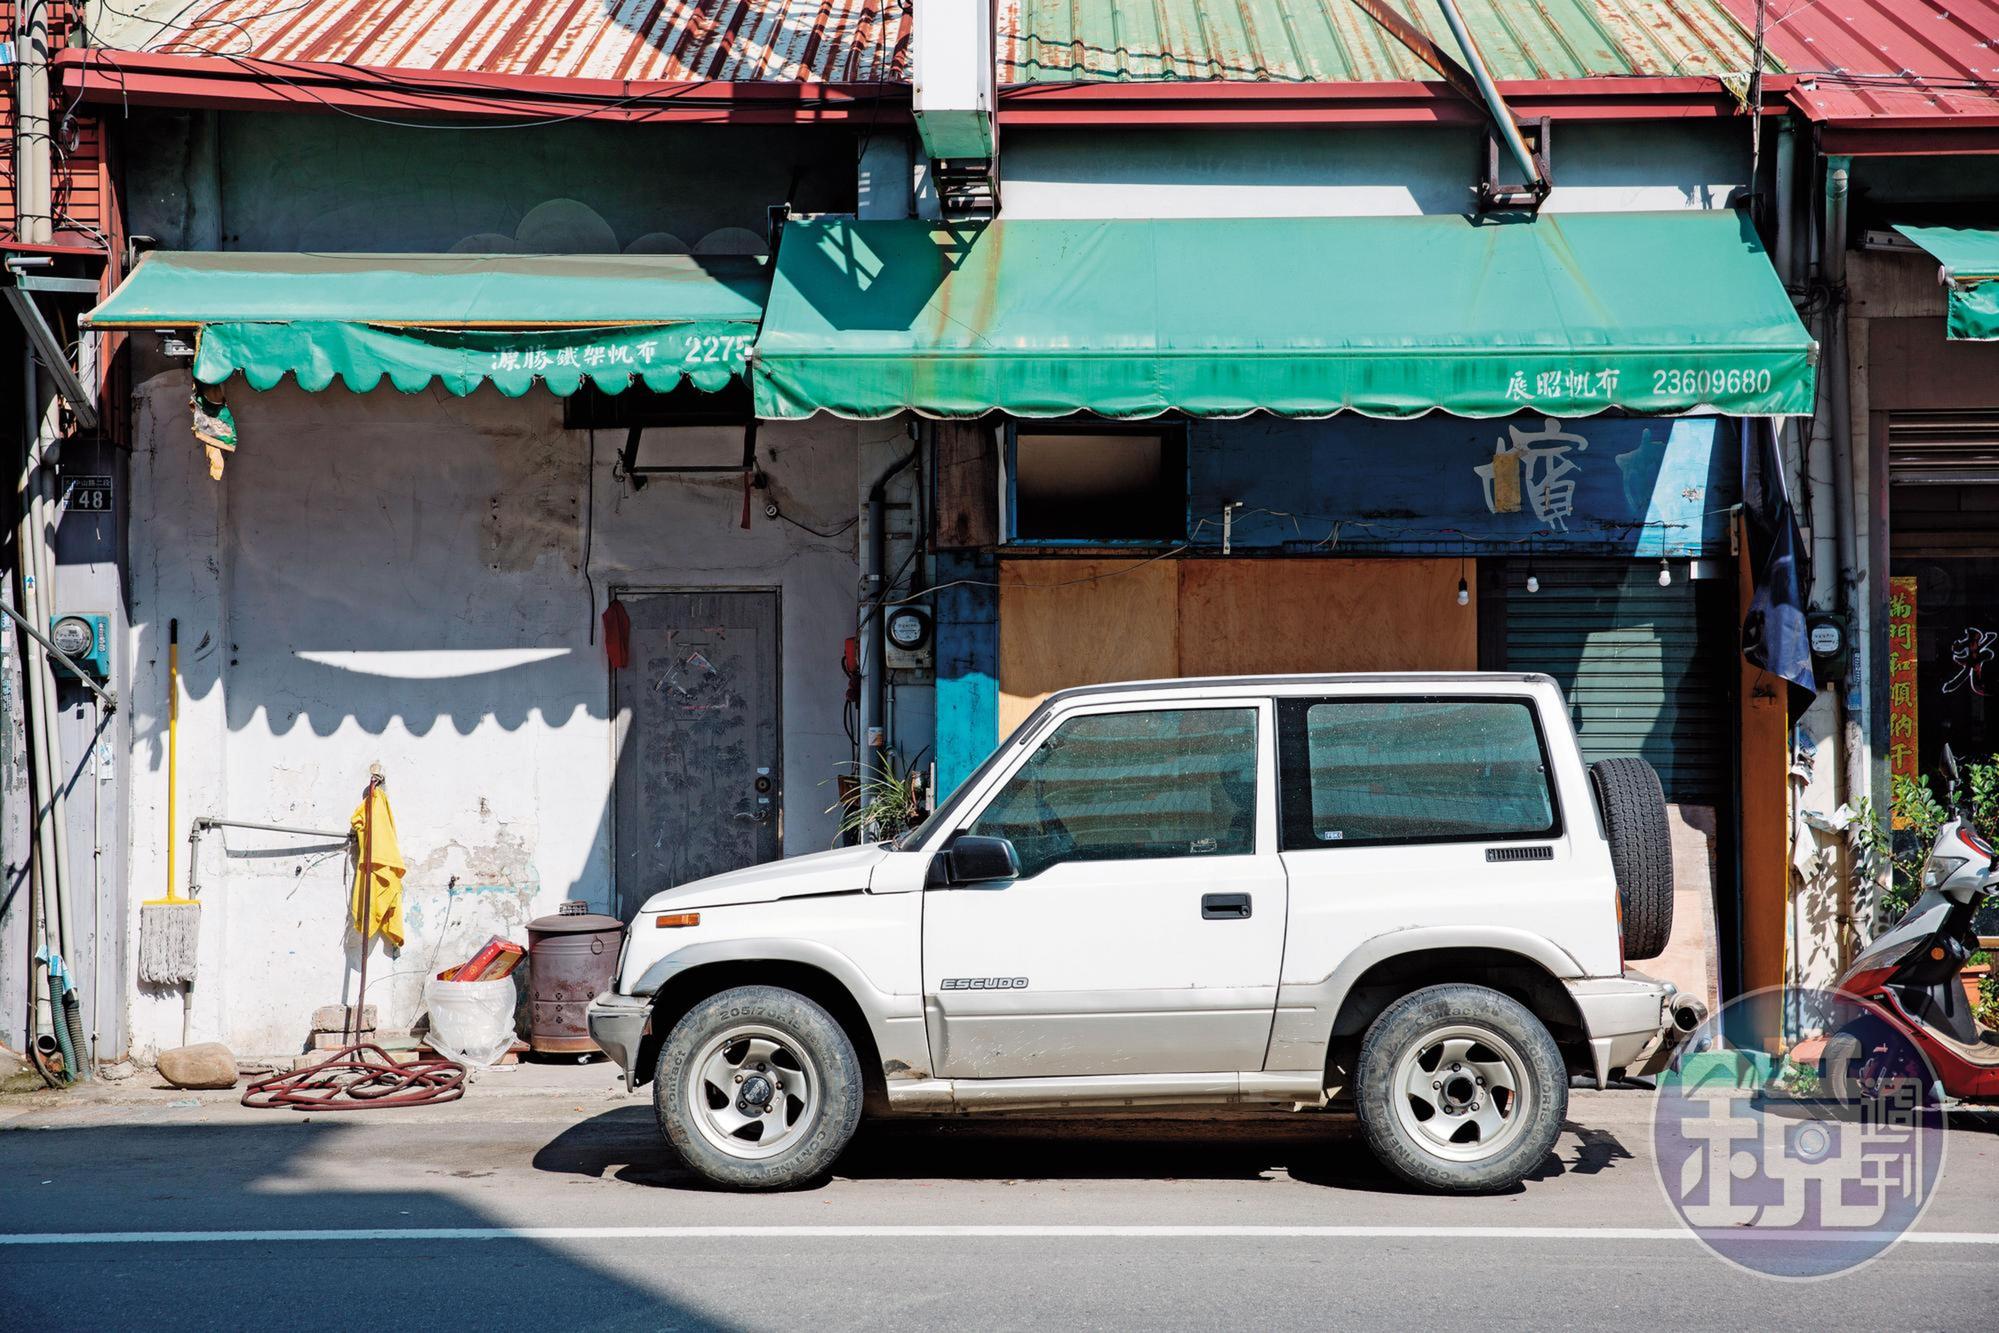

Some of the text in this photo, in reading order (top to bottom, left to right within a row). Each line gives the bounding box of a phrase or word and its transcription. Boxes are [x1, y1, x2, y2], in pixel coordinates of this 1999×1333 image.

[491, 341, 659, 371] 源勝鐵架帆布
[1505, 368, 1772, 400] 展昭帆布 23609680
[79, 490, 103, 509] 48
[940, 977, 1029, 990] ESCUDO
